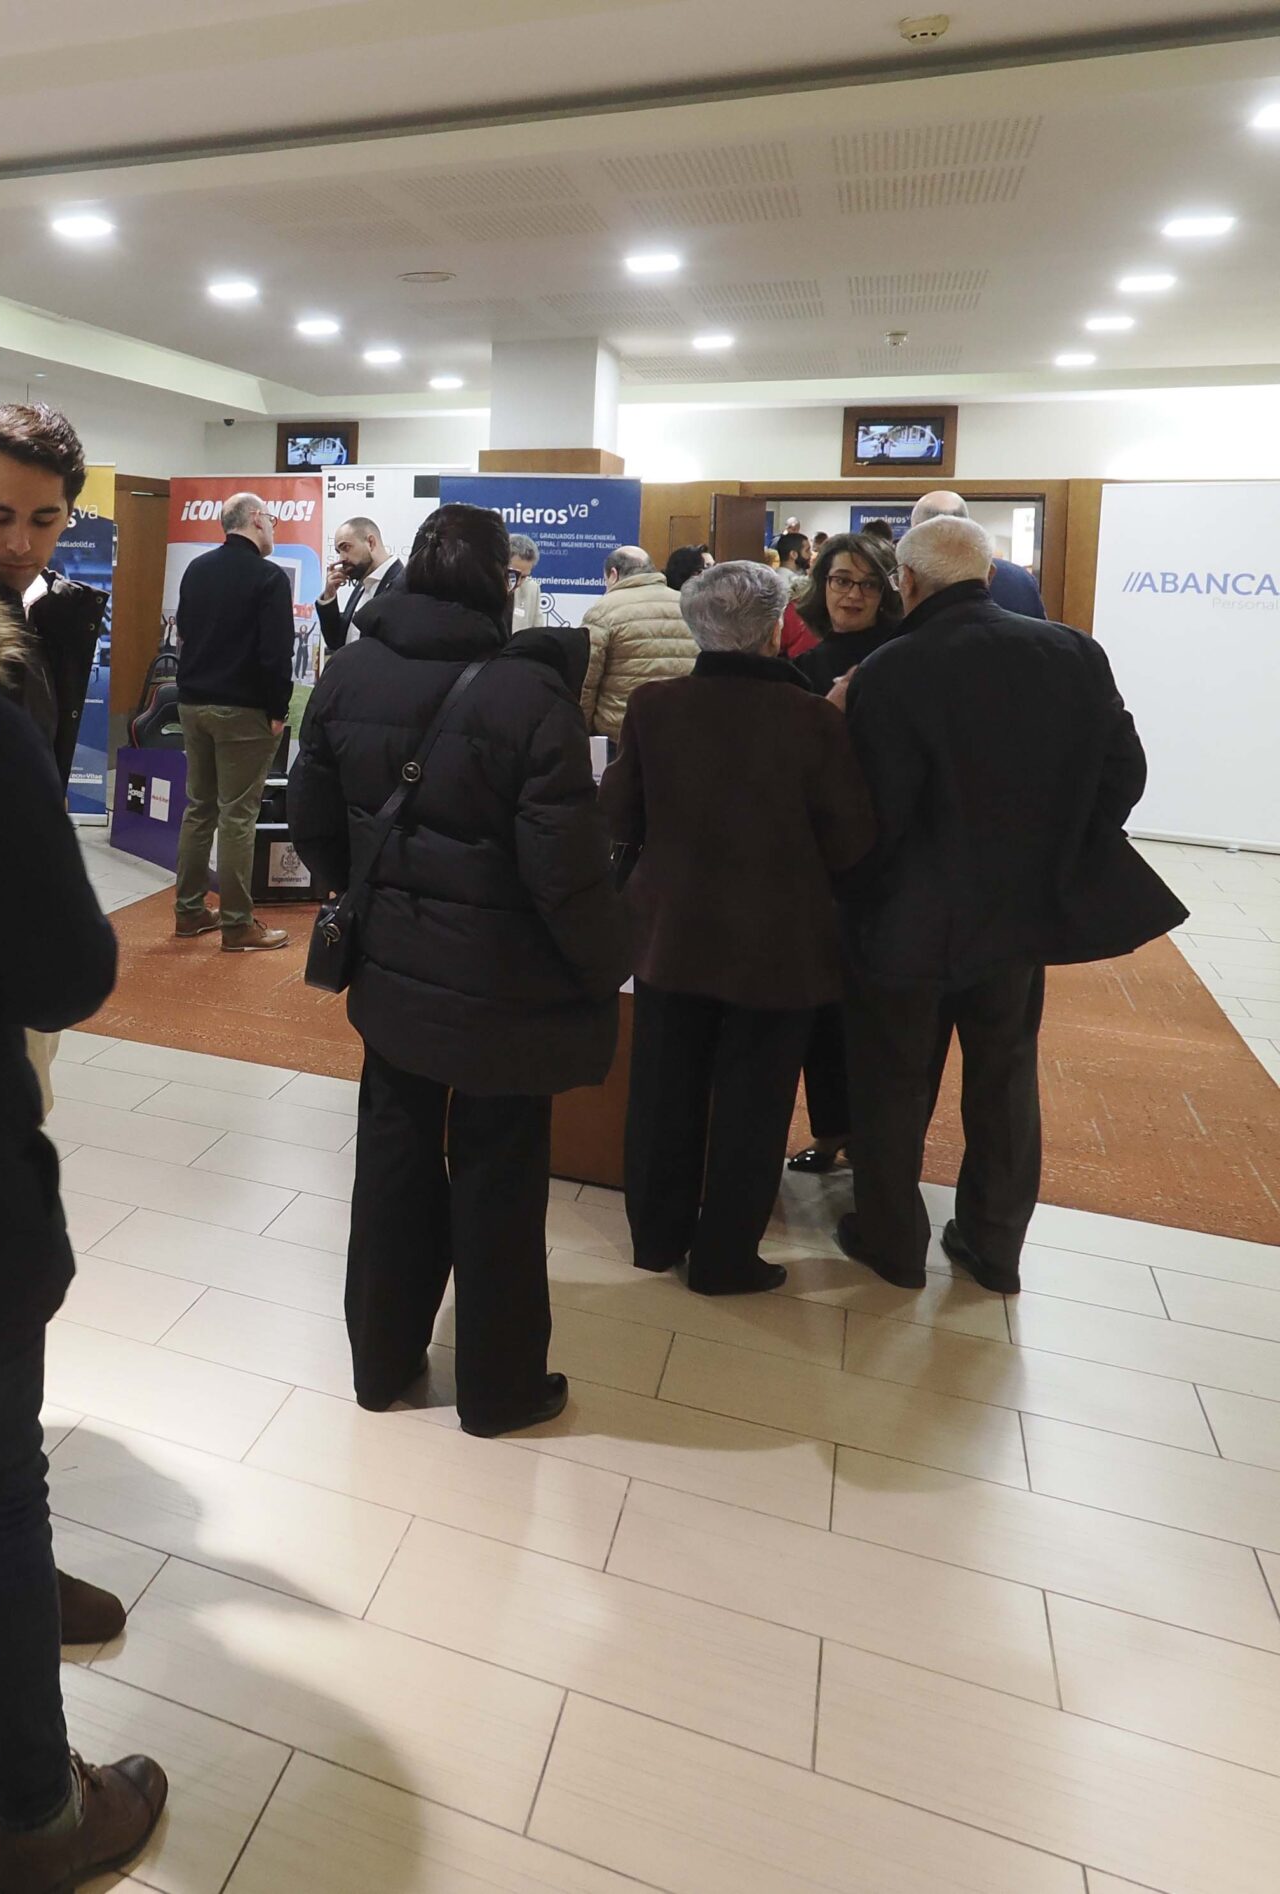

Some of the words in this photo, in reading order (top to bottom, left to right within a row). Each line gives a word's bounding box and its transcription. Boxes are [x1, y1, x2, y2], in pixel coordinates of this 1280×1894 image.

[327, 482, 375, 492] HORSE
[181, 500, 315, 521] ¡CONNOS!
[540, 532, 575, 540] GRADUADOS
[561, 541, 595, 549] INGENIEROS
